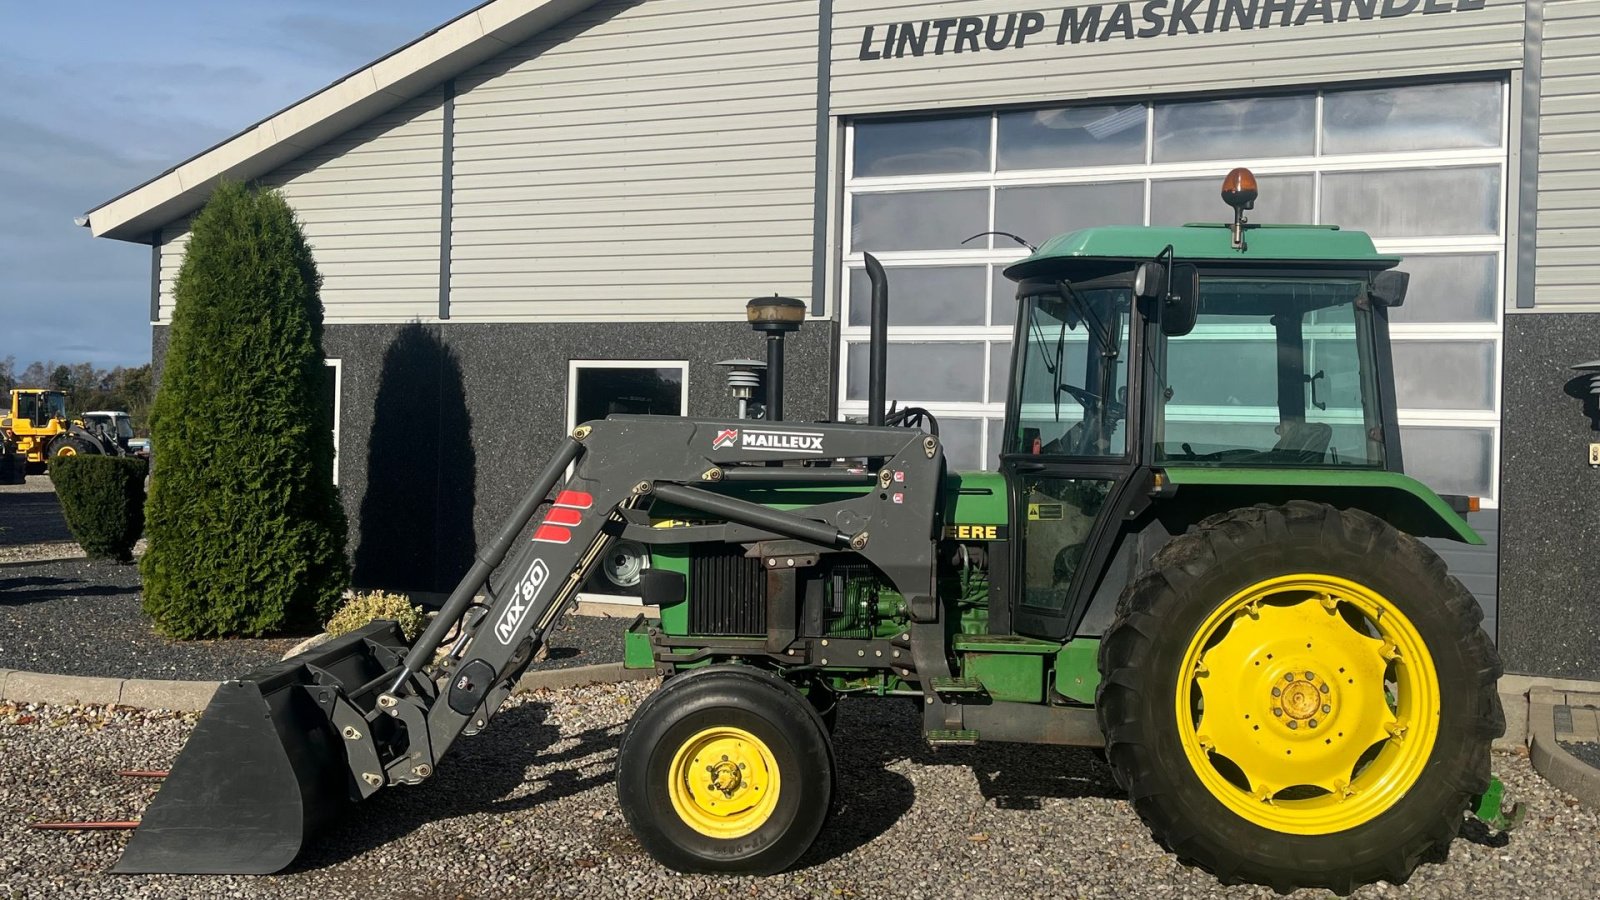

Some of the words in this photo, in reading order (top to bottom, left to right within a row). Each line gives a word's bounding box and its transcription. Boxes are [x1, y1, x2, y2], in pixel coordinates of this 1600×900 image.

[859, 12, 1045, 61] LINTRUP
[1056, 0, 1486, 45] MASKINHAN
[742, 433, 823, 450] MAILLEUX
[944, 525, 997, 539] EERE
[499, 582, 526, 639] MX
[522, 565, 544, 601] 80
